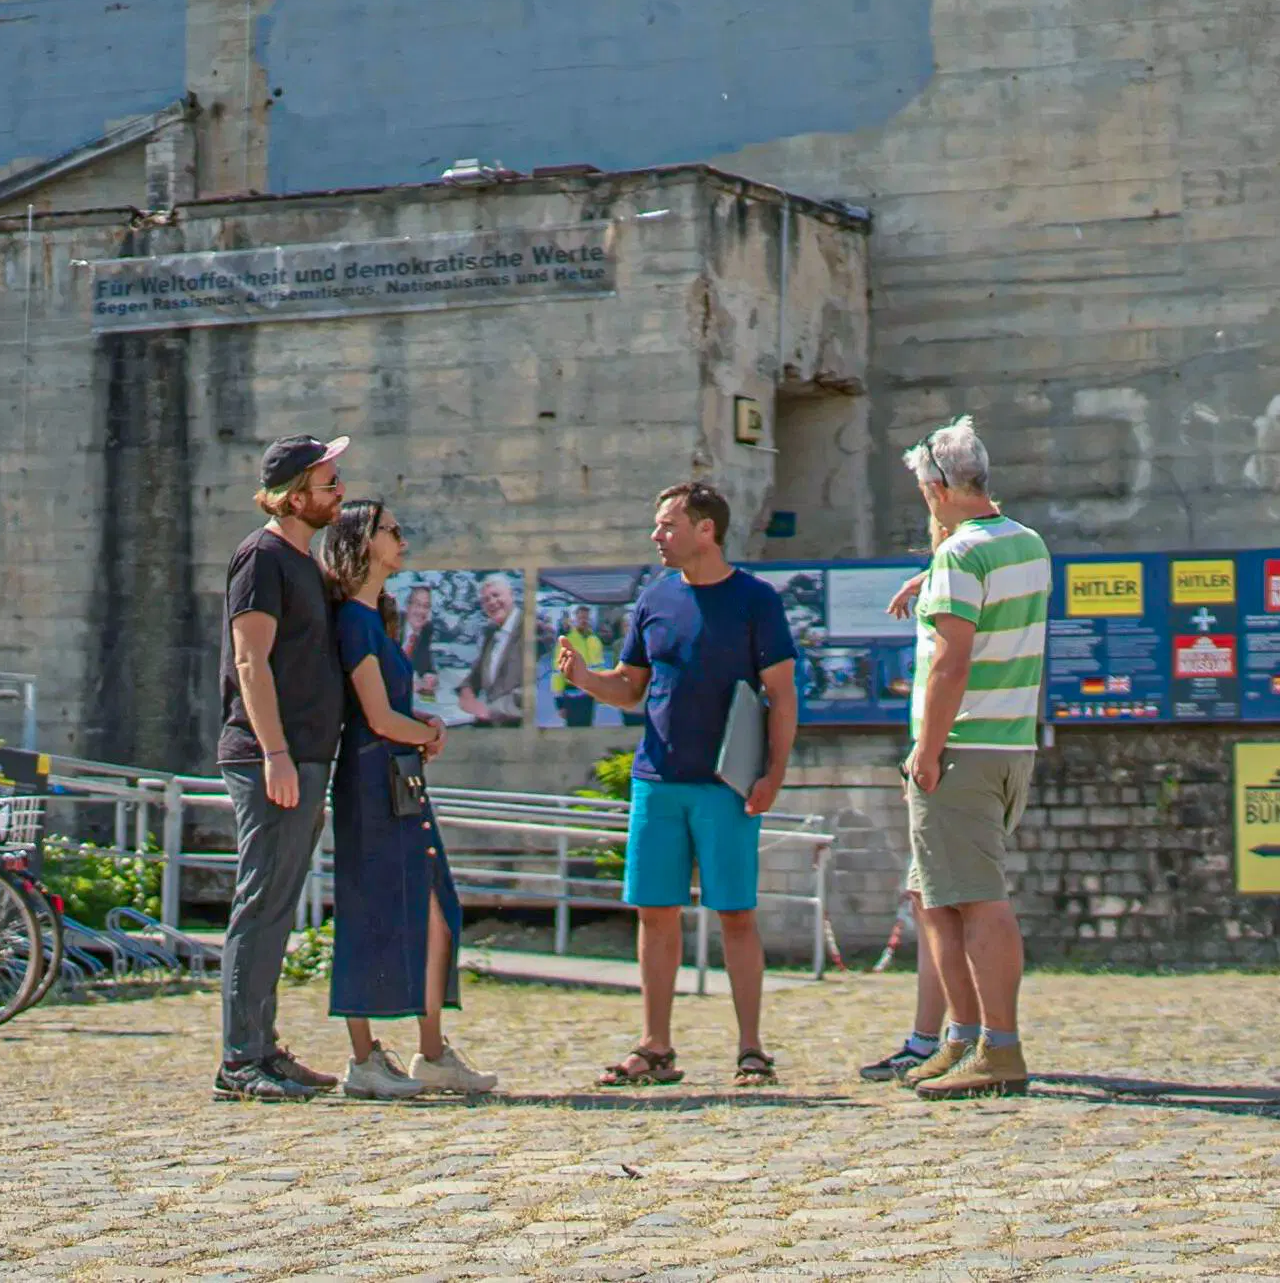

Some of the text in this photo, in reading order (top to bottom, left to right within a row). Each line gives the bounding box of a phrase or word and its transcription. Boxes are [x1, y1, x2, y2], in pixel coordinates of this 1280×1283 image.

[96, 244, 607, 299] Für Weltoffenheit und demokratische Werte
[96, 300, 150, 317] Gegen
[385, 272, 511, 295] Nationalismus
[516, 269, 549, 285] und
[1072, 580, 1138, 596] HITLER
[1176, 574, 1231, 587] HITLER
